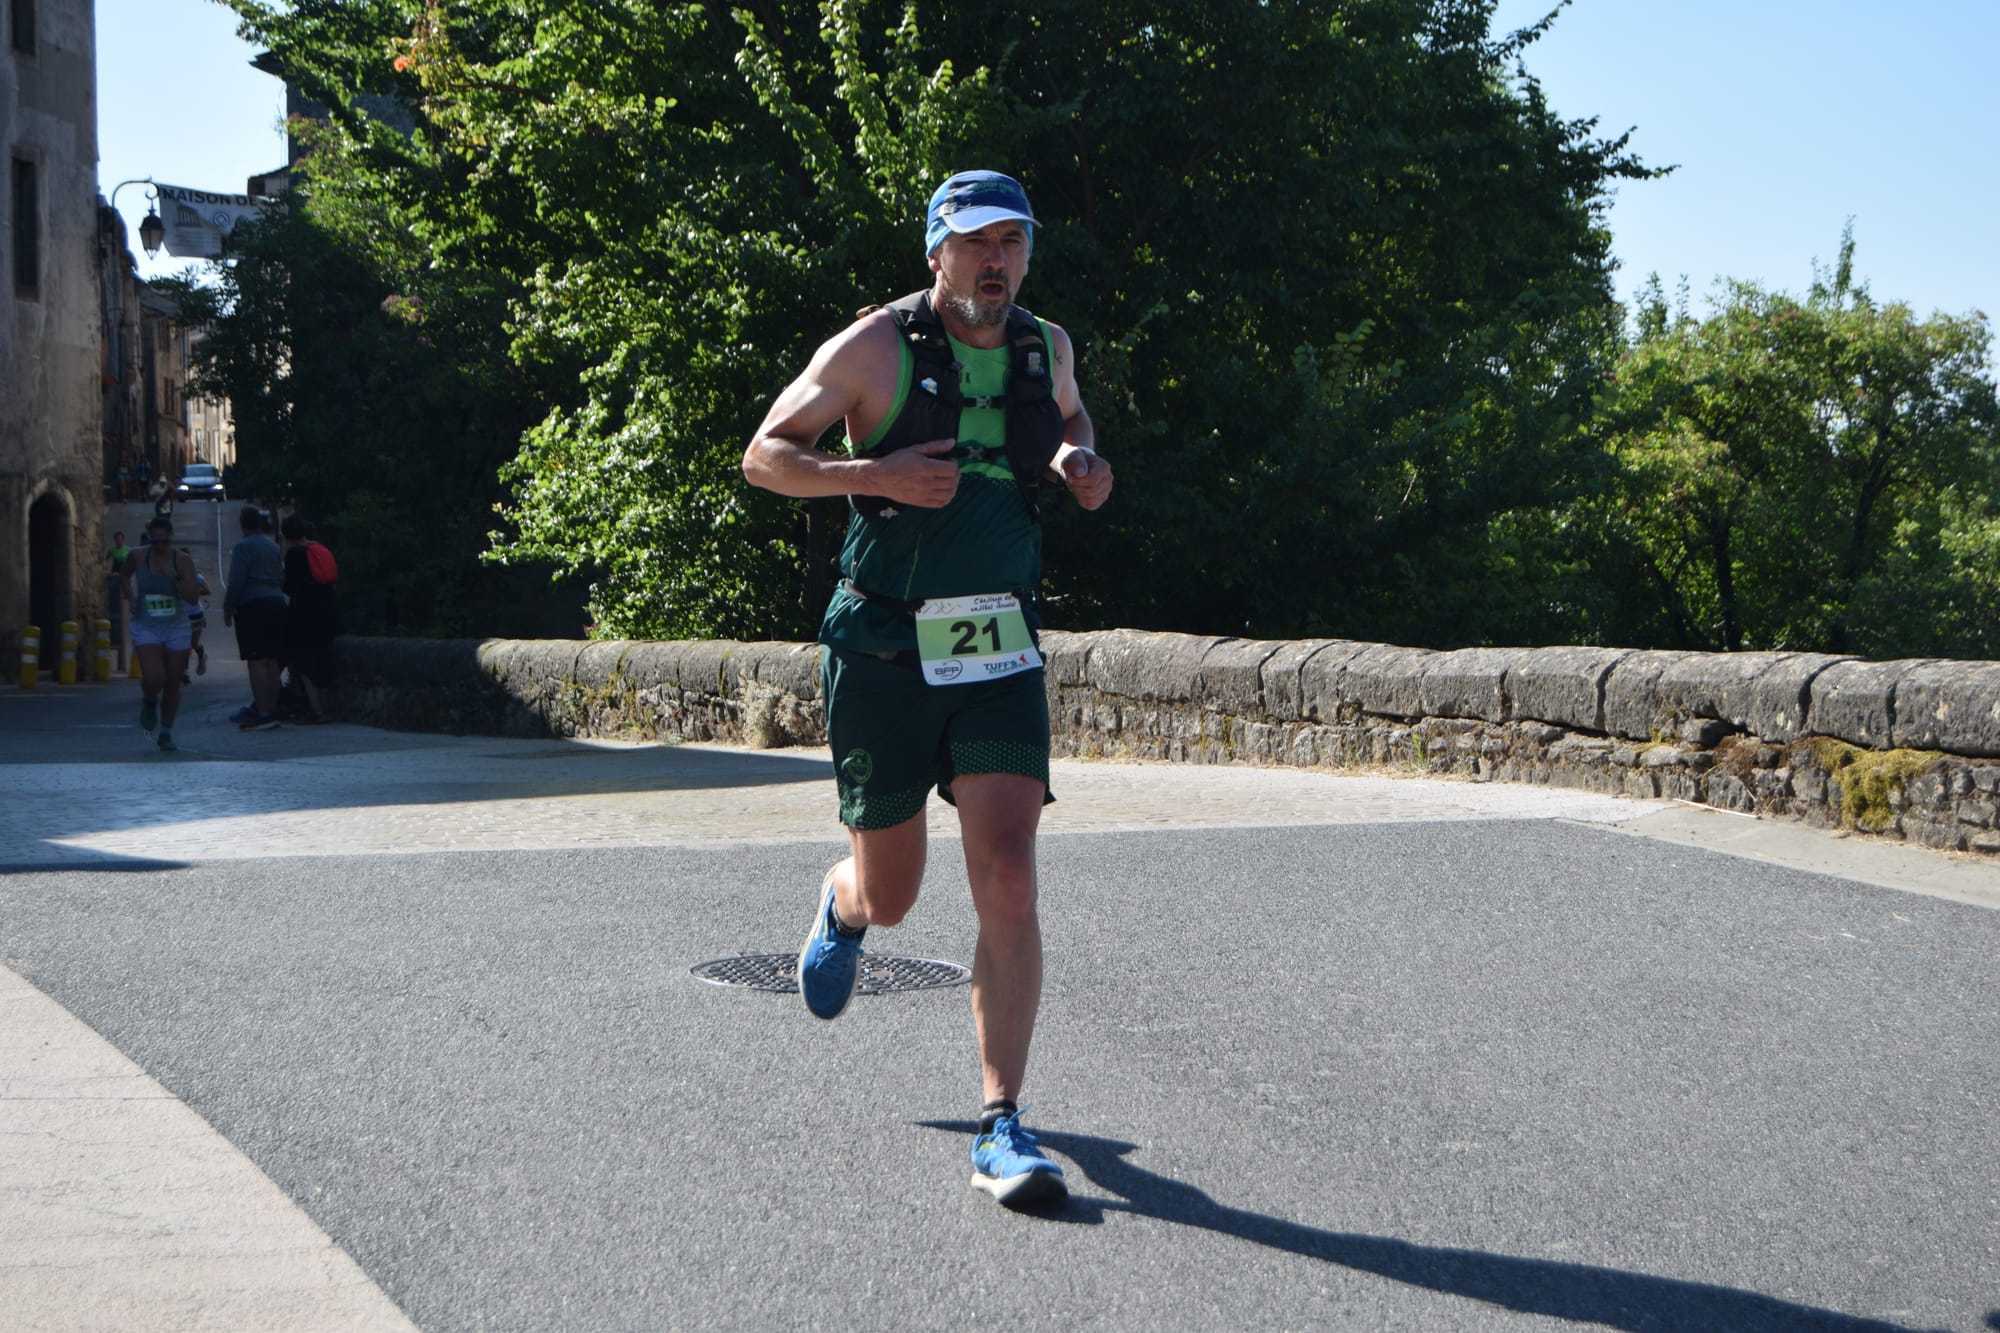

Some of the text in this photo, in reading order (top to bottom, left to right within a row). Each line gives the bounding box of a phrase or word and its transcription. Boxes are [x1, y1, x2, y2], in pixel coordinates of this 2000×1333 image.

[163, 188, 258, 207] MAISON DE
[950, 616, 1002, 656] 21
[934, 666, 959, 676] BFP
